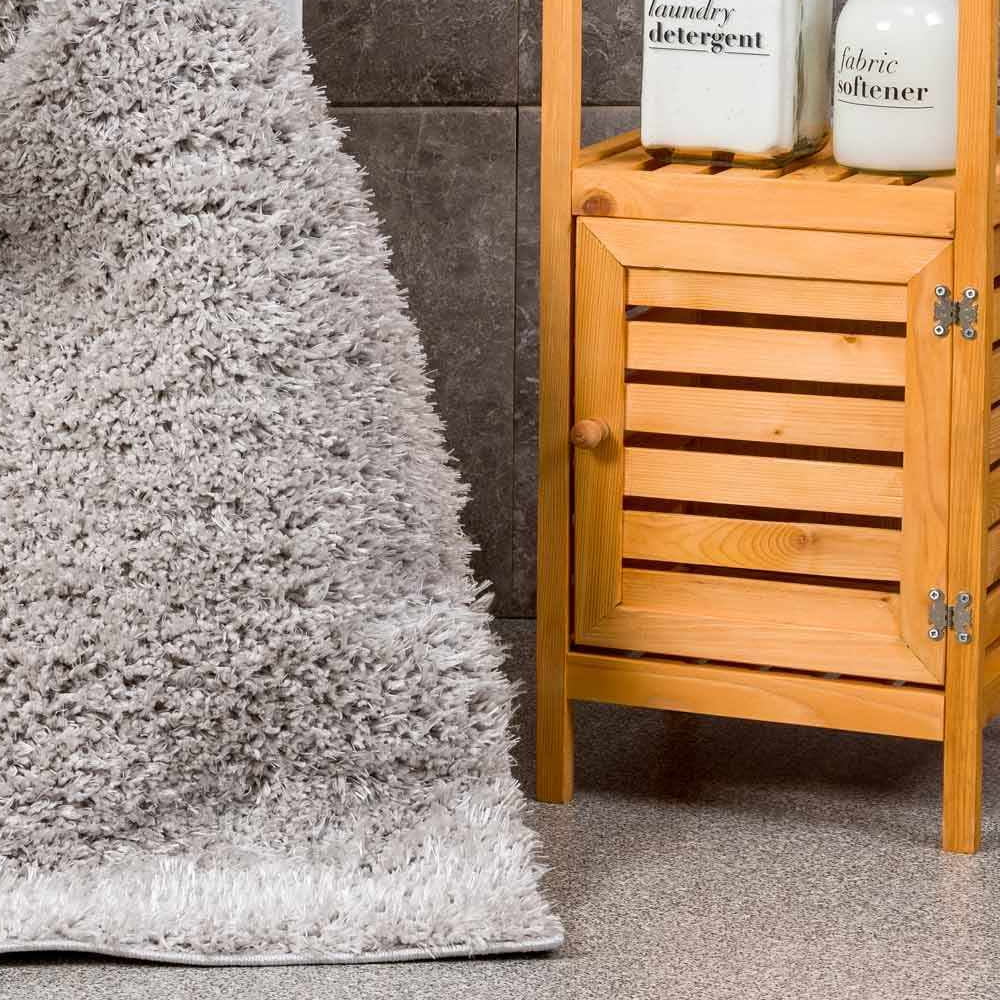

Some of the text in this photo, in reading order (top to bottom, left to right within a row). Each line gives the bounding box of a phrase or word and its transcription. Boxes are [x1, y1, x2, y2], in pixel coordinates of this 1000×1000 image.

[648, 21, 763, 54] detergent
[838, 46, 899, 74] fabric
[837, 75, 929, 102] softener
